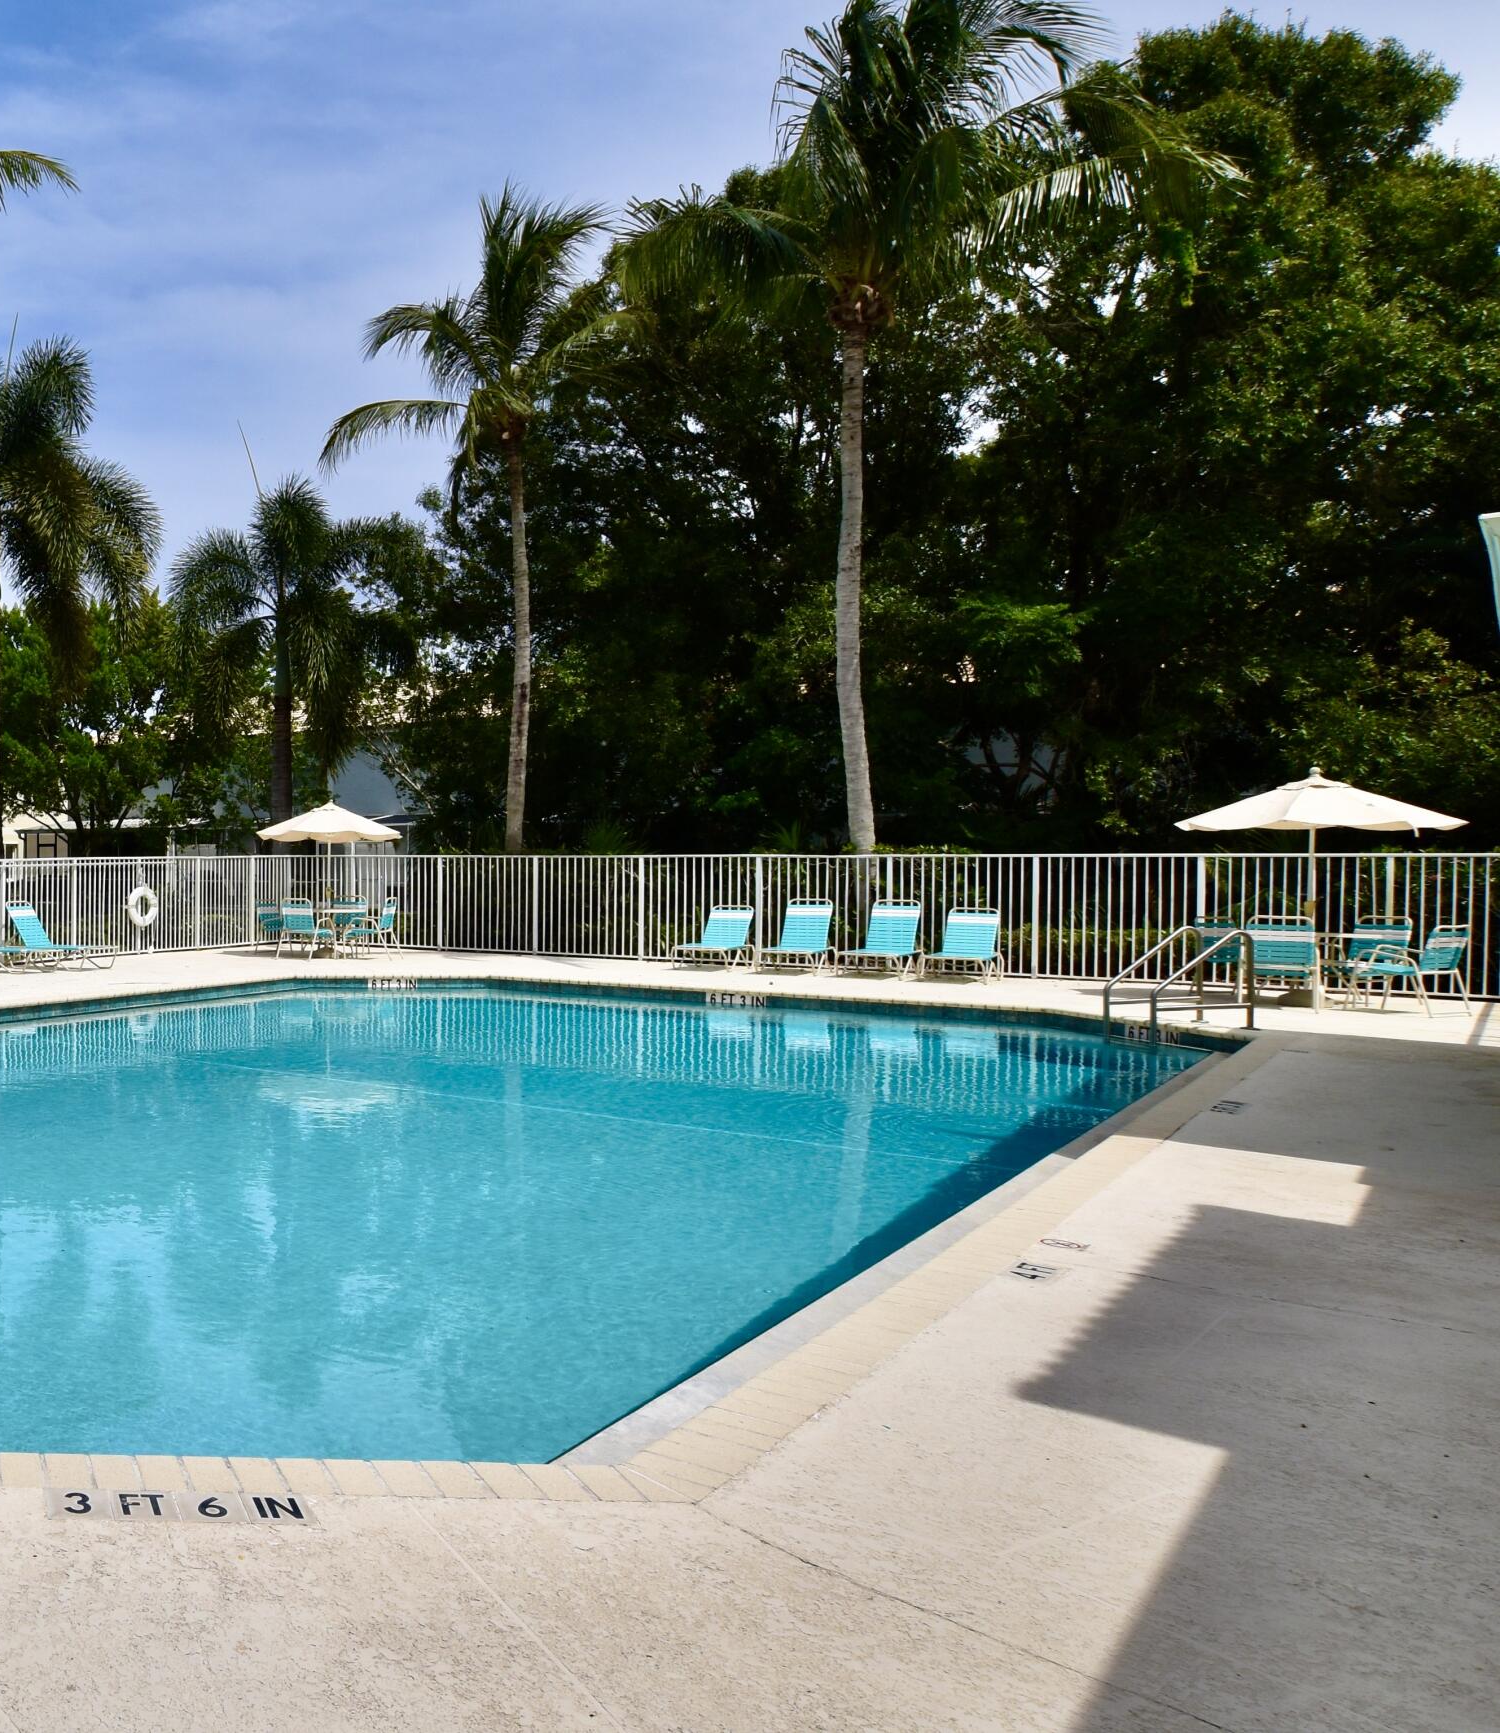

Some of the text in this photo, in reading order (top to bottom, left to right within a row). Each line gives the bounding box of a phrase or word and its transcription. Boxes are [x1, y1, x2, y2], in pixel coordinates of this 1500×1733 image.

[380, 979, 392, 991] FT
[405, 979, 417, 991] IN
[710, 993, 765, 1008] 6 FT 3 IN
[1128, 1026, 1135, 1039] 6
[1165, 1031, 1179, 1045] IN
[1009, 1262, 1058, 1280] 4 FT
[64, 1492, 304, 1519] 3 FT 6 IN
